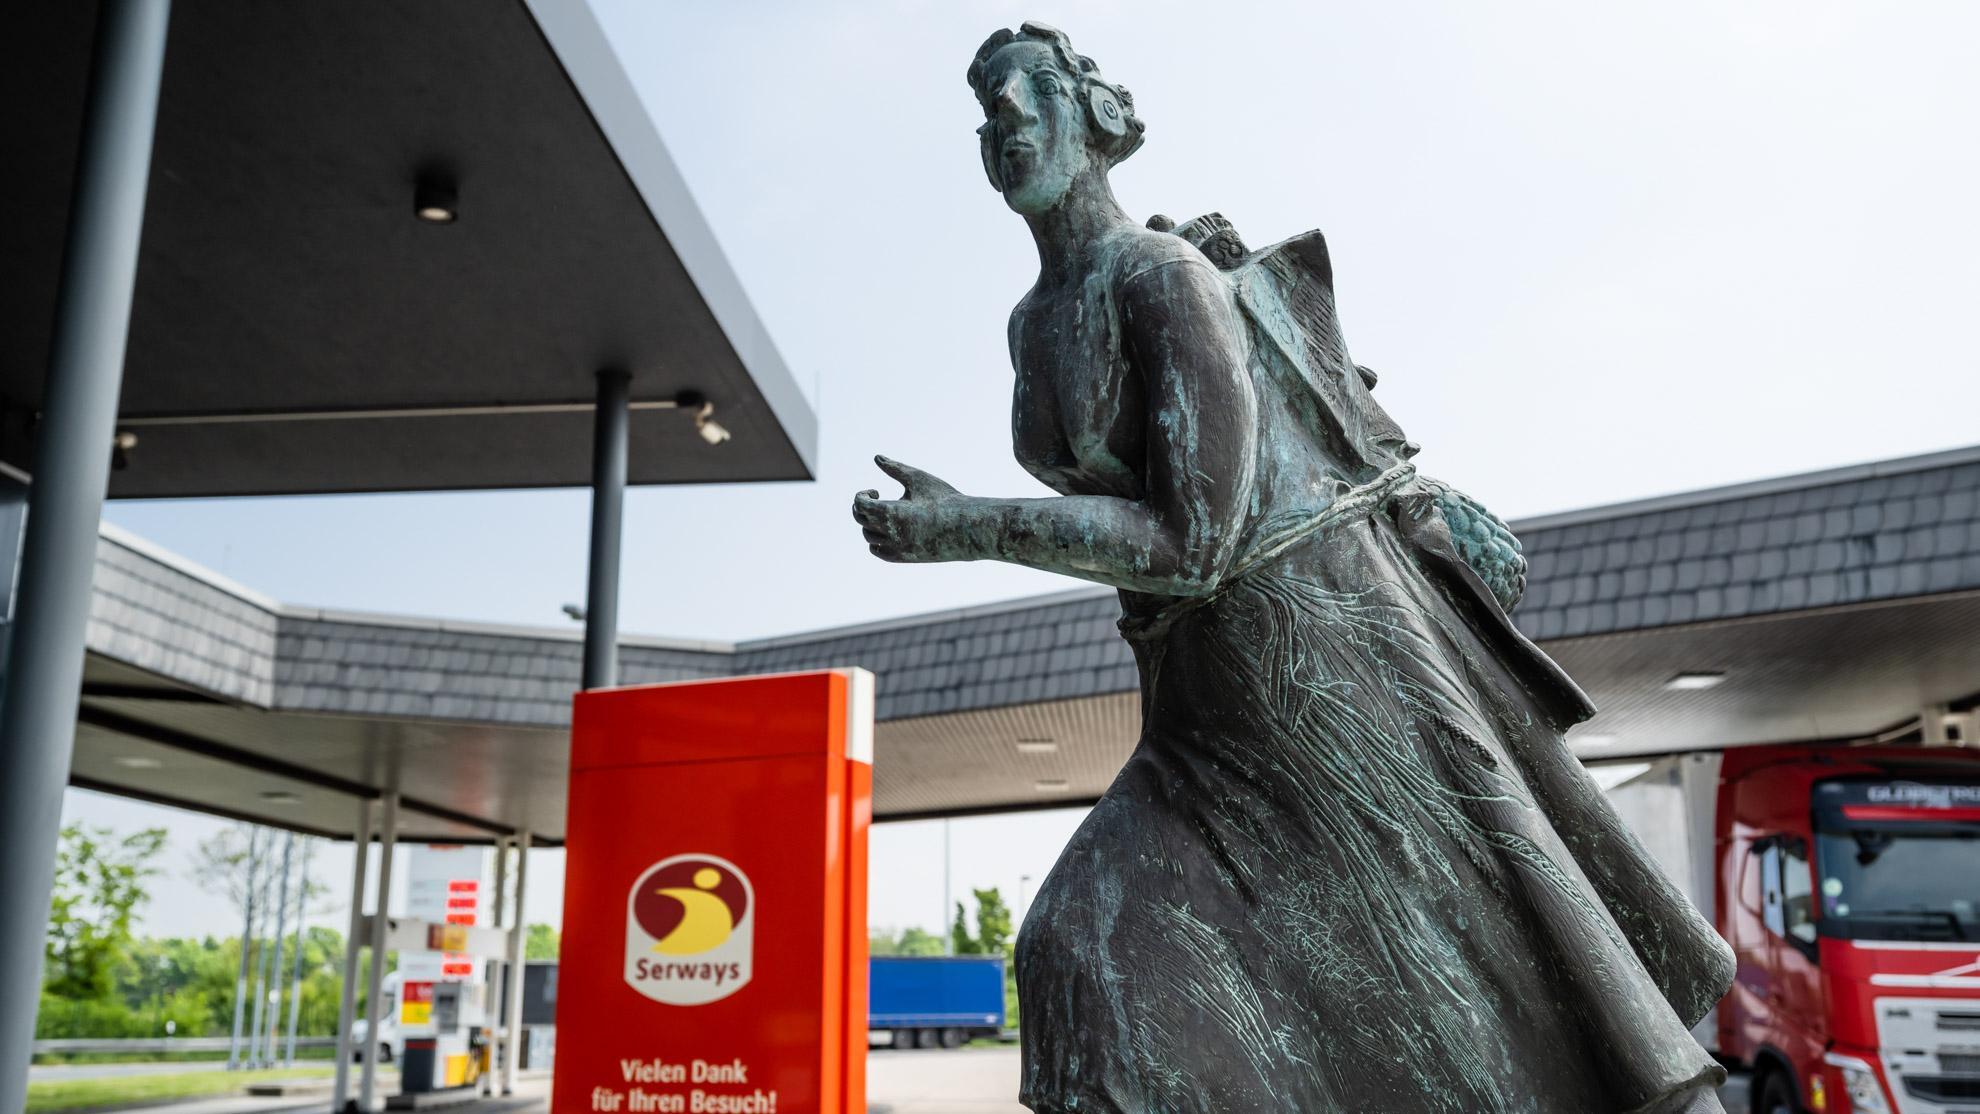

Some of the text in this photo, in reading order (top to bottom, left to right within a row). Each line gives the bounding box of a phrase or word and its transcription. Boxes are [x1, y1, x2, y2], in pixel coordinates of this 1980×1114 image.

[636, 958, 740, 986] Serways
[620, 1058, 748, 1084] Vielen Dank
[591, 1086, 777, 1114] für Ihren Besuch!
